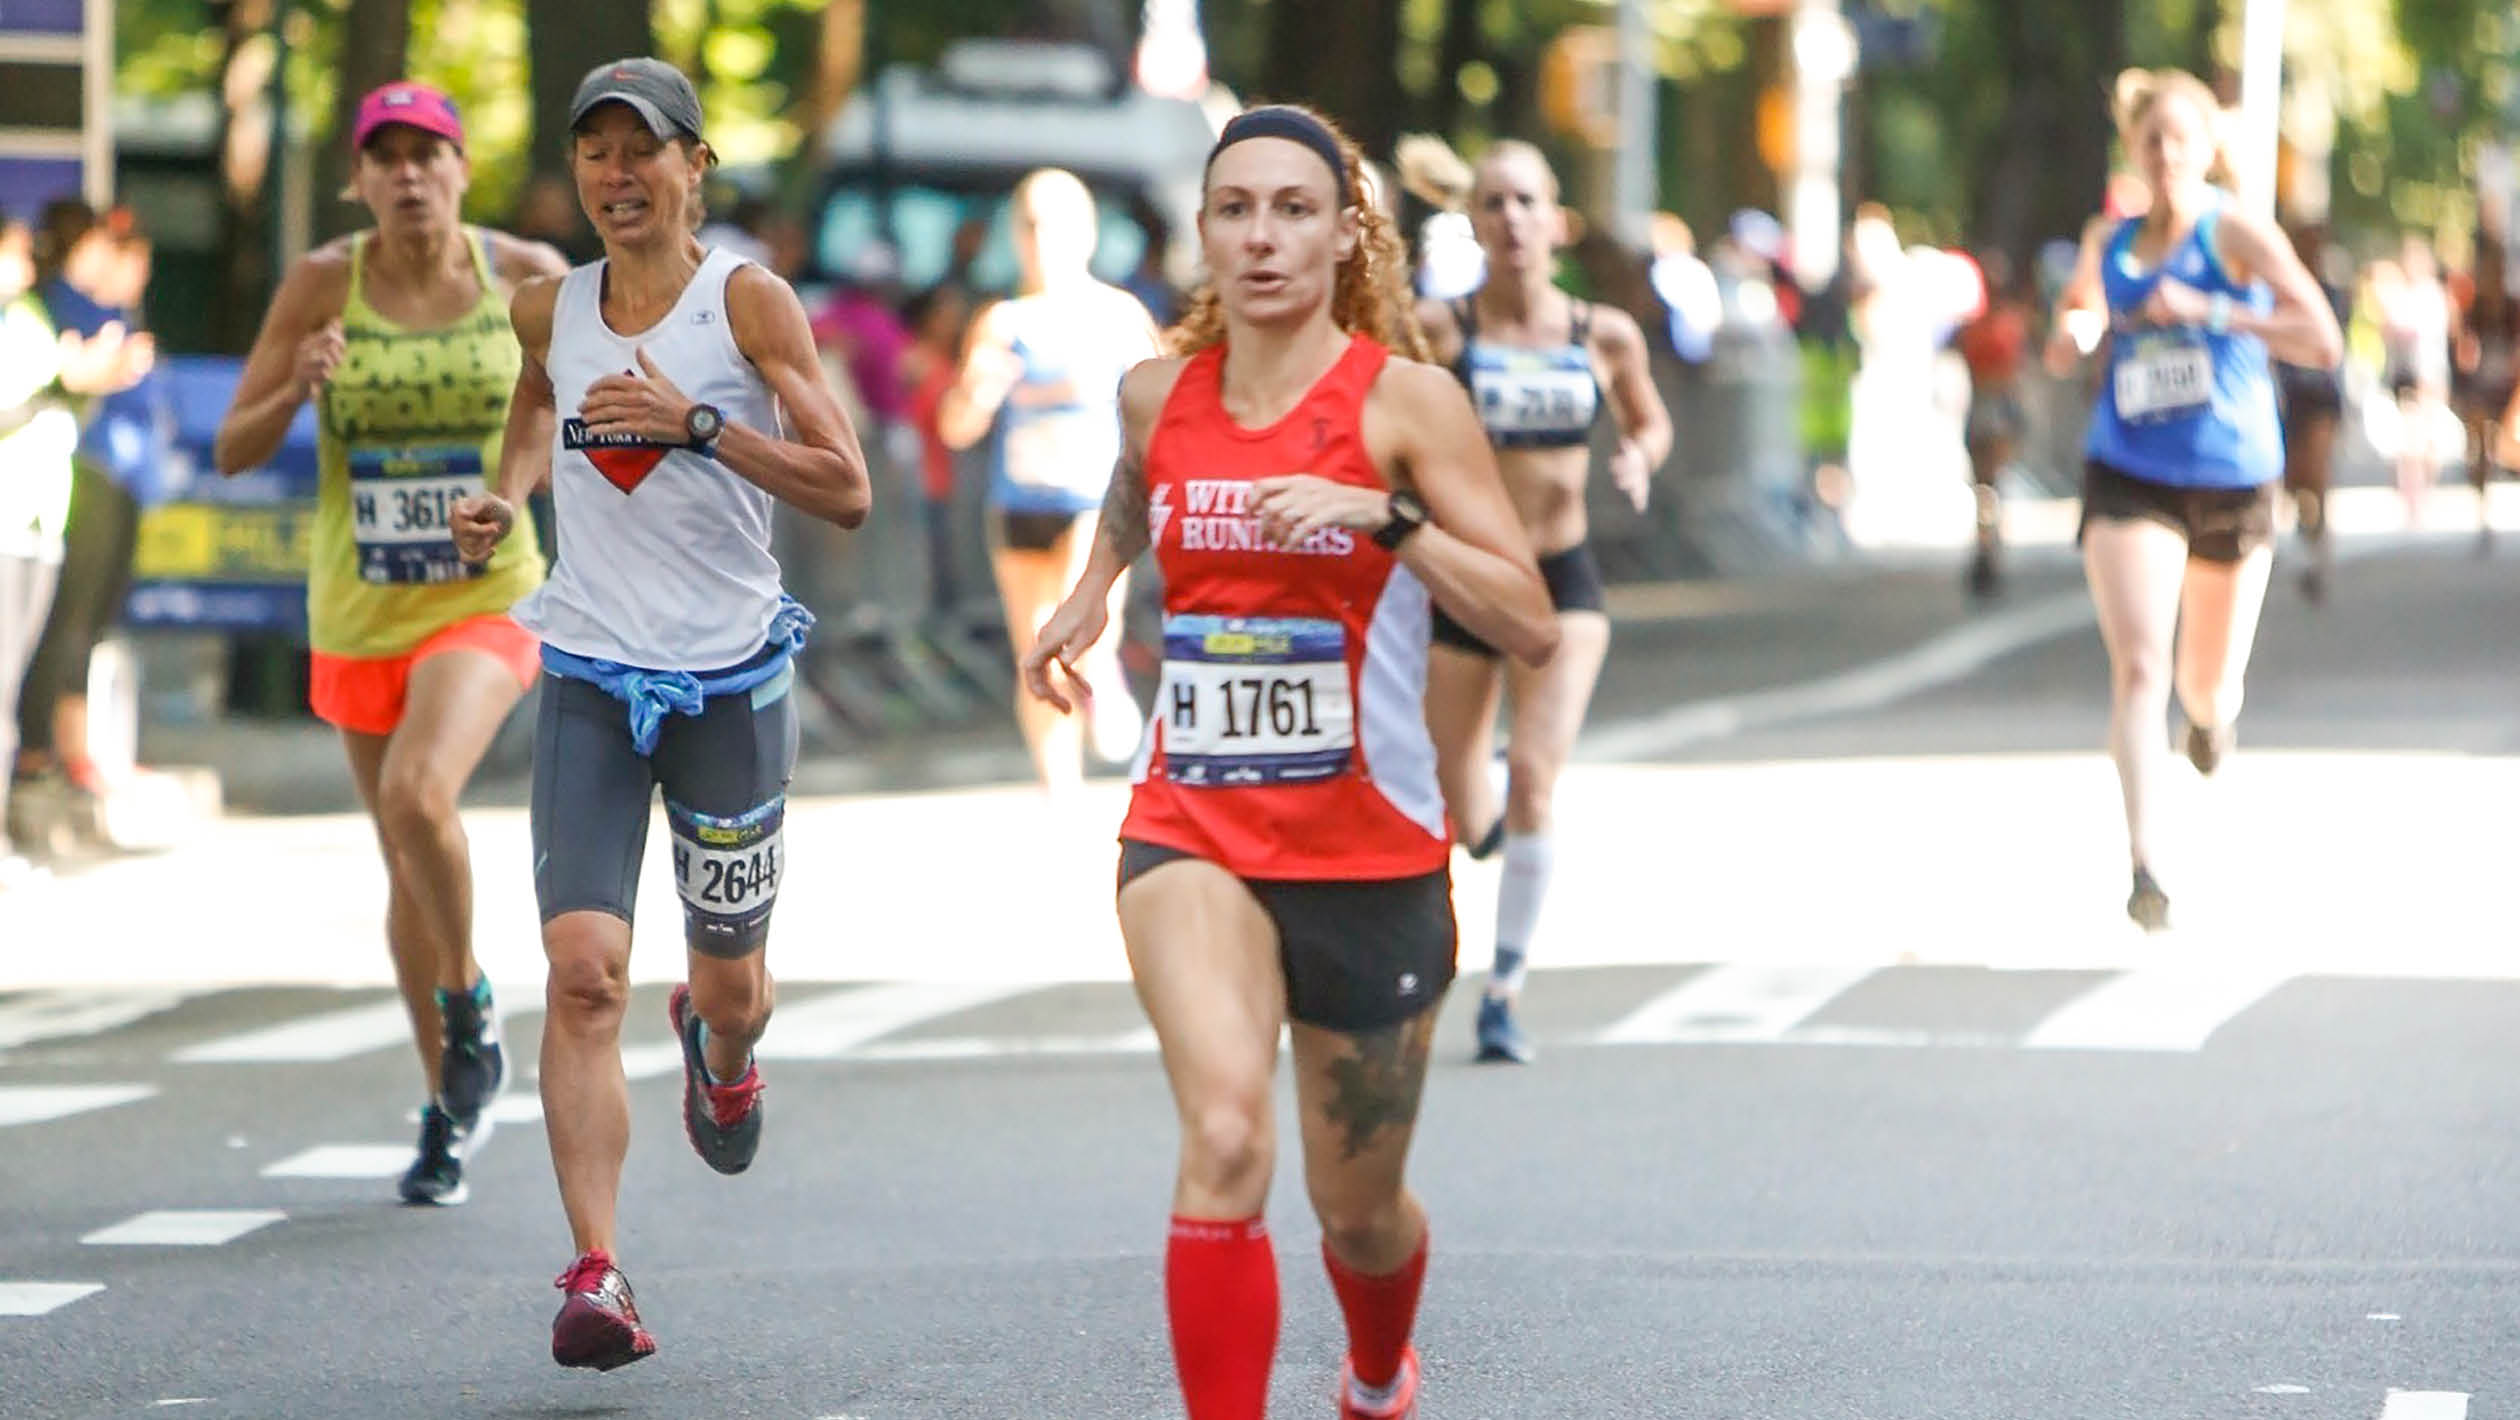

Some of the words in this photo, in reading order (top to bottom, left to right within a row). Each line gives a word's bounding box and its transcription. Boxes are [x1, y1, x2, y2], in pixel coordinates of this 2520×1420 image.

[356, 492, 377, 525] H
[1173, 683, 1196, 729] H
[1219, 677, 1322, 738] 1761
[701, 845, 776, 904] 2644
